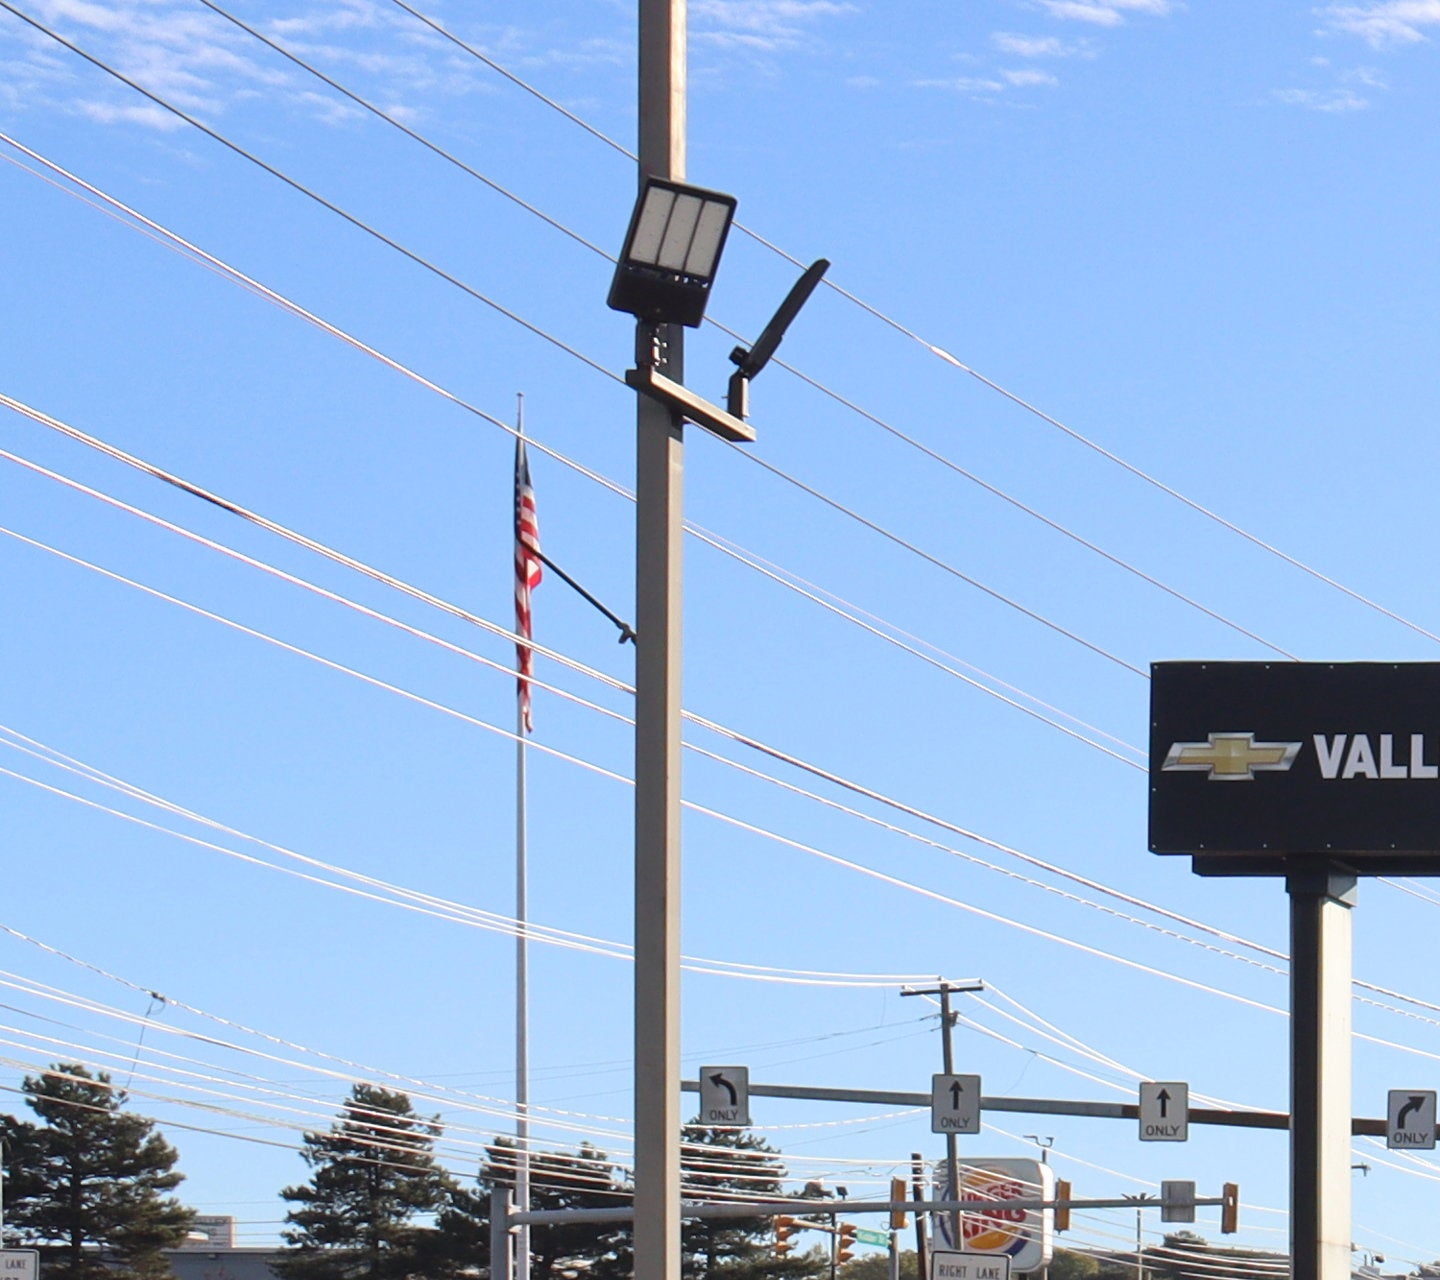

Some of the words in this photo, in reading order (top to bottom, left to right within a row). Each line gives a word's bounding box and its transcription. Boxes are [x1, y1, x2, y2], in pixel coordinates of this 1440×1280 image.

[709, 1109, 739, 1121] ONLY
[940, 1116, 971, 1129] ONLY
[1145, 1124, 1181, 1137] ONLY
[1393, 1131, 1430, 1144] ONLY
[5, 1258, 26, 1270] LANE
[938, 1263, 968, 1279] RIGHT
[976, 1266, 1001, 1280] LANE
